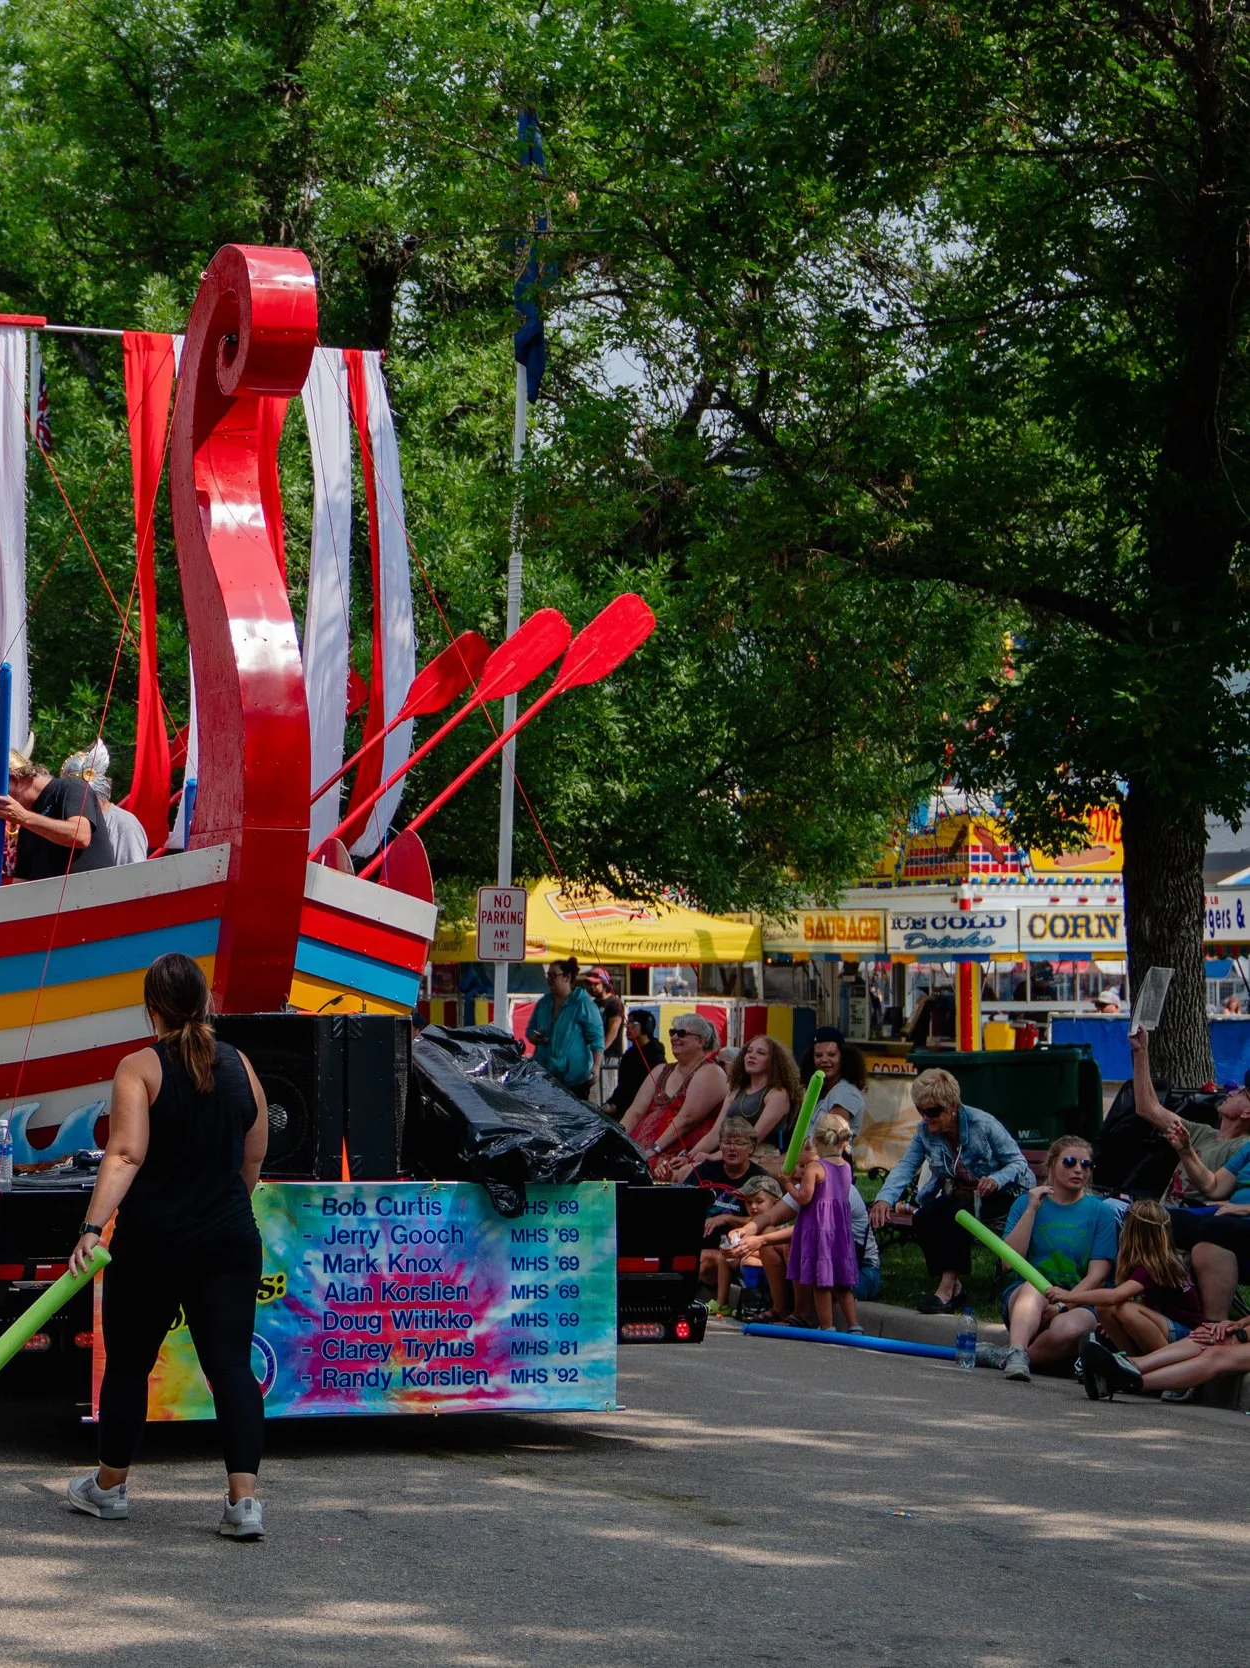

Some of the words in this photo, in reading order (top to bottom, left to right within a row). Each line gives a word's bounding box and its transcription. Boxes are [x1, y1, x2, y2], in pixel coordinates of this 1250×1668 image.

[494, 895, 512, 908] NO
[481, 910, 523, 925] PARKING
[890, 915, 927, 930] ICE
[930, 914, 1007, 930] COLD
[1028, 912, 1121, 941] CORN
[1203, 908, 1231, 938] rgers
[1237, 898, 1246, 929] &
[494, 930, 509, 939] ANY
[803, 915, 881, 942] SAUSAGE
[493, 942, 510, 952] TIME
[571, 938, 592, 955] Big
[594, 937, 637, 952] Flavor
[638, 938, 691, 957] Country
[904, 931, 996, 950] Drinks
[322, 1197, 366, 1216] Bob
[375, 1196, 442, 1216] Curtis
[523, 1200, 548, 1215] HS
[555, 1200, 579, 1215] '69
[323, 1225, 380, 1249] Jerry
[390, 1224, 464, 1245] Gooch
[511, 1228, 549, 1243] MHS
[555, 1228, 579, 1243] '69
[323, 1254, 379, 1274] Mark
[388, 1253, 443, 1273] Knox
[511, 1256, 549, 1271] MHS
[555, 1256, 580, 1271] '69
[324, 1282, 373, 1302] Alan
[381, 1281, 468, 1302] Korslien
[511, 1284, 549, 1299] MHS
[555, 1284, 580, 1299] '69
[322, 1310, 381, 1335] Doug
[391, 1309, 473, 1330] Witikko
[511, 1312, 549, 1327] MHS
[555, 1312, 580, 1327] '69
[321, 1338, 392, 1362] Clarey
[402, 1337, 475, 1362] Tryhus
[510, 1341, 549, 1355] MHS
[555, 1341, 578, 1355] '81
[322, 1368, 392, 1391] Randy
[402, 1365, 488, 1388] Korslien
[510, 1368, 548, 1384] MHS
[553, 1368, 579, 1383] '92
